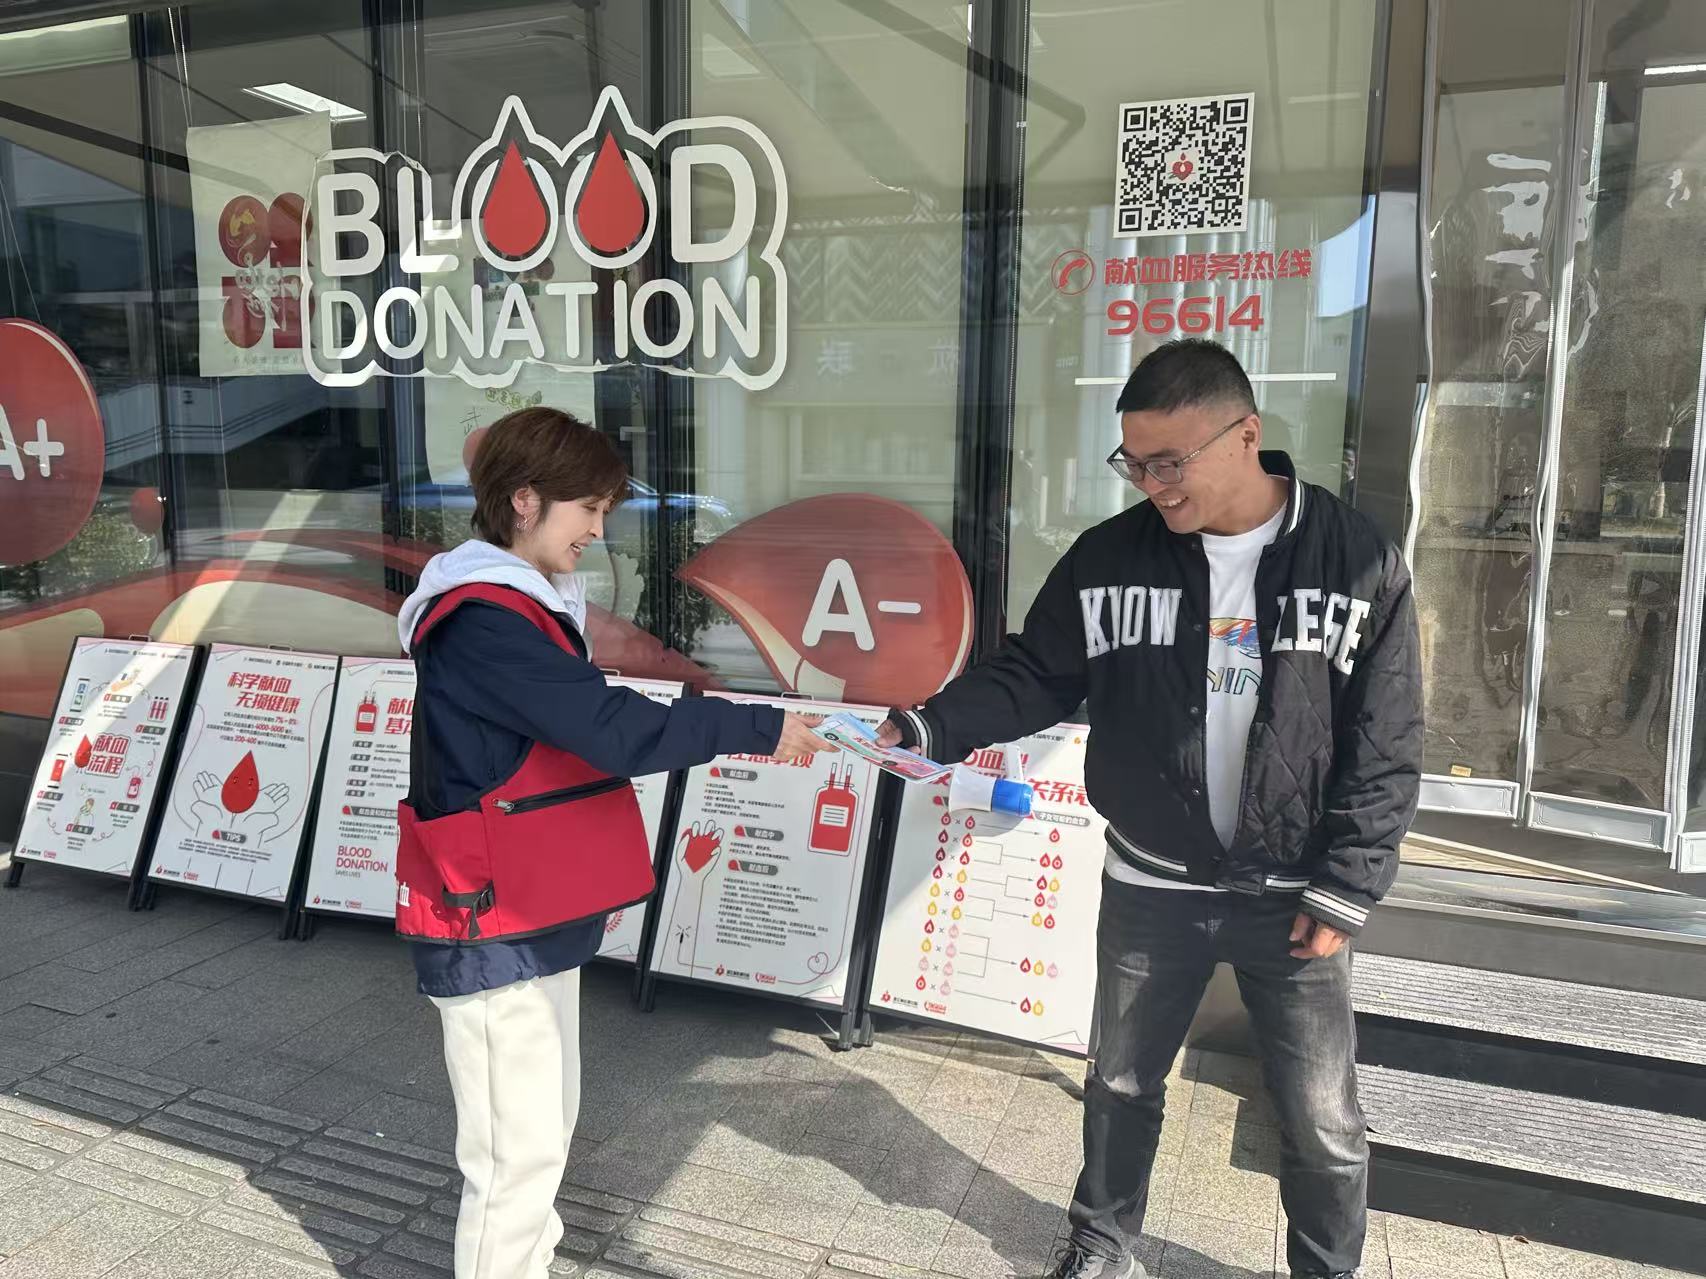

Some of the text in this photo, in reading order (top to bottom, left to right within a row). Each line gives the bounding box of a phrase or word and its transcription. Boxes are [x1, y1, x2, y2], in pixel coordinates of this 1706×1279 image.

[317, 130, 757, 277] BLOOD
[1103, 249, 1313, 286] 献血服务热线
[320, 275, 760, 359] DONATION
[1107, 295, 1265, 336] 96614
[227, 671, 292, 694] 科学献血
[236, 691, 301, 714] 无损健康
[93, 735, 129, 755] 献血
[88, 754, 124, 775] 流程
[225, 832, 241, 842] TIPS
[337, 845, 372, 858] BLOOD
[336, 857, 388, 873] DONATION
